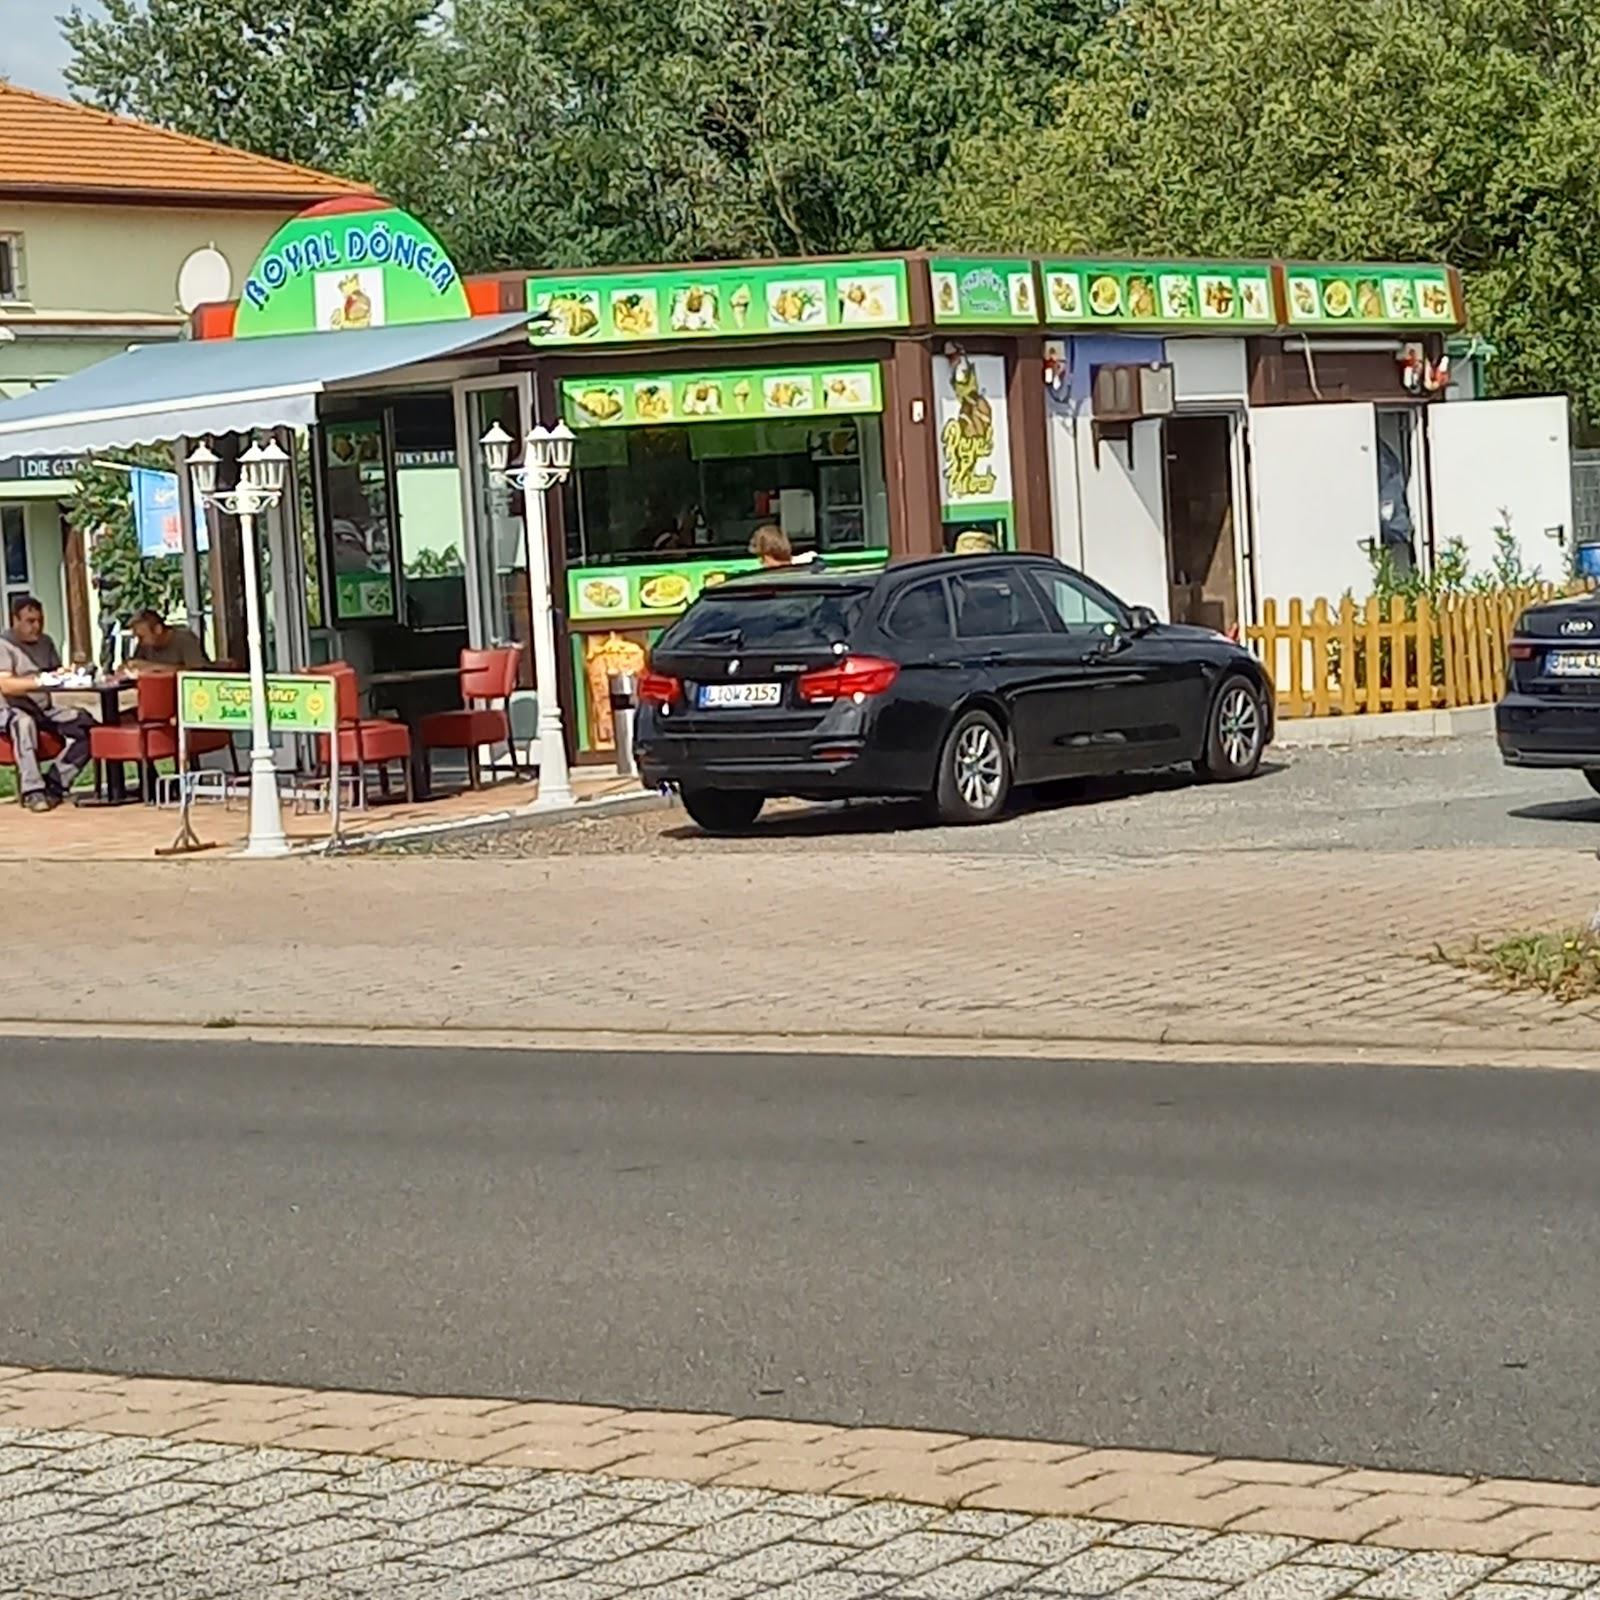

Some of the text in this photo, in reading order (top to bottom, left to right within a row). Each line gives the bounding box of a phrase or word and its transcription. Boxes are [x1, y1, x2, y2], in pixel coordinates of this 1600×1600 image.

[244, 221, 457, 312] ROYAL DÖNER
[27, 459, 51, 477] DIE
